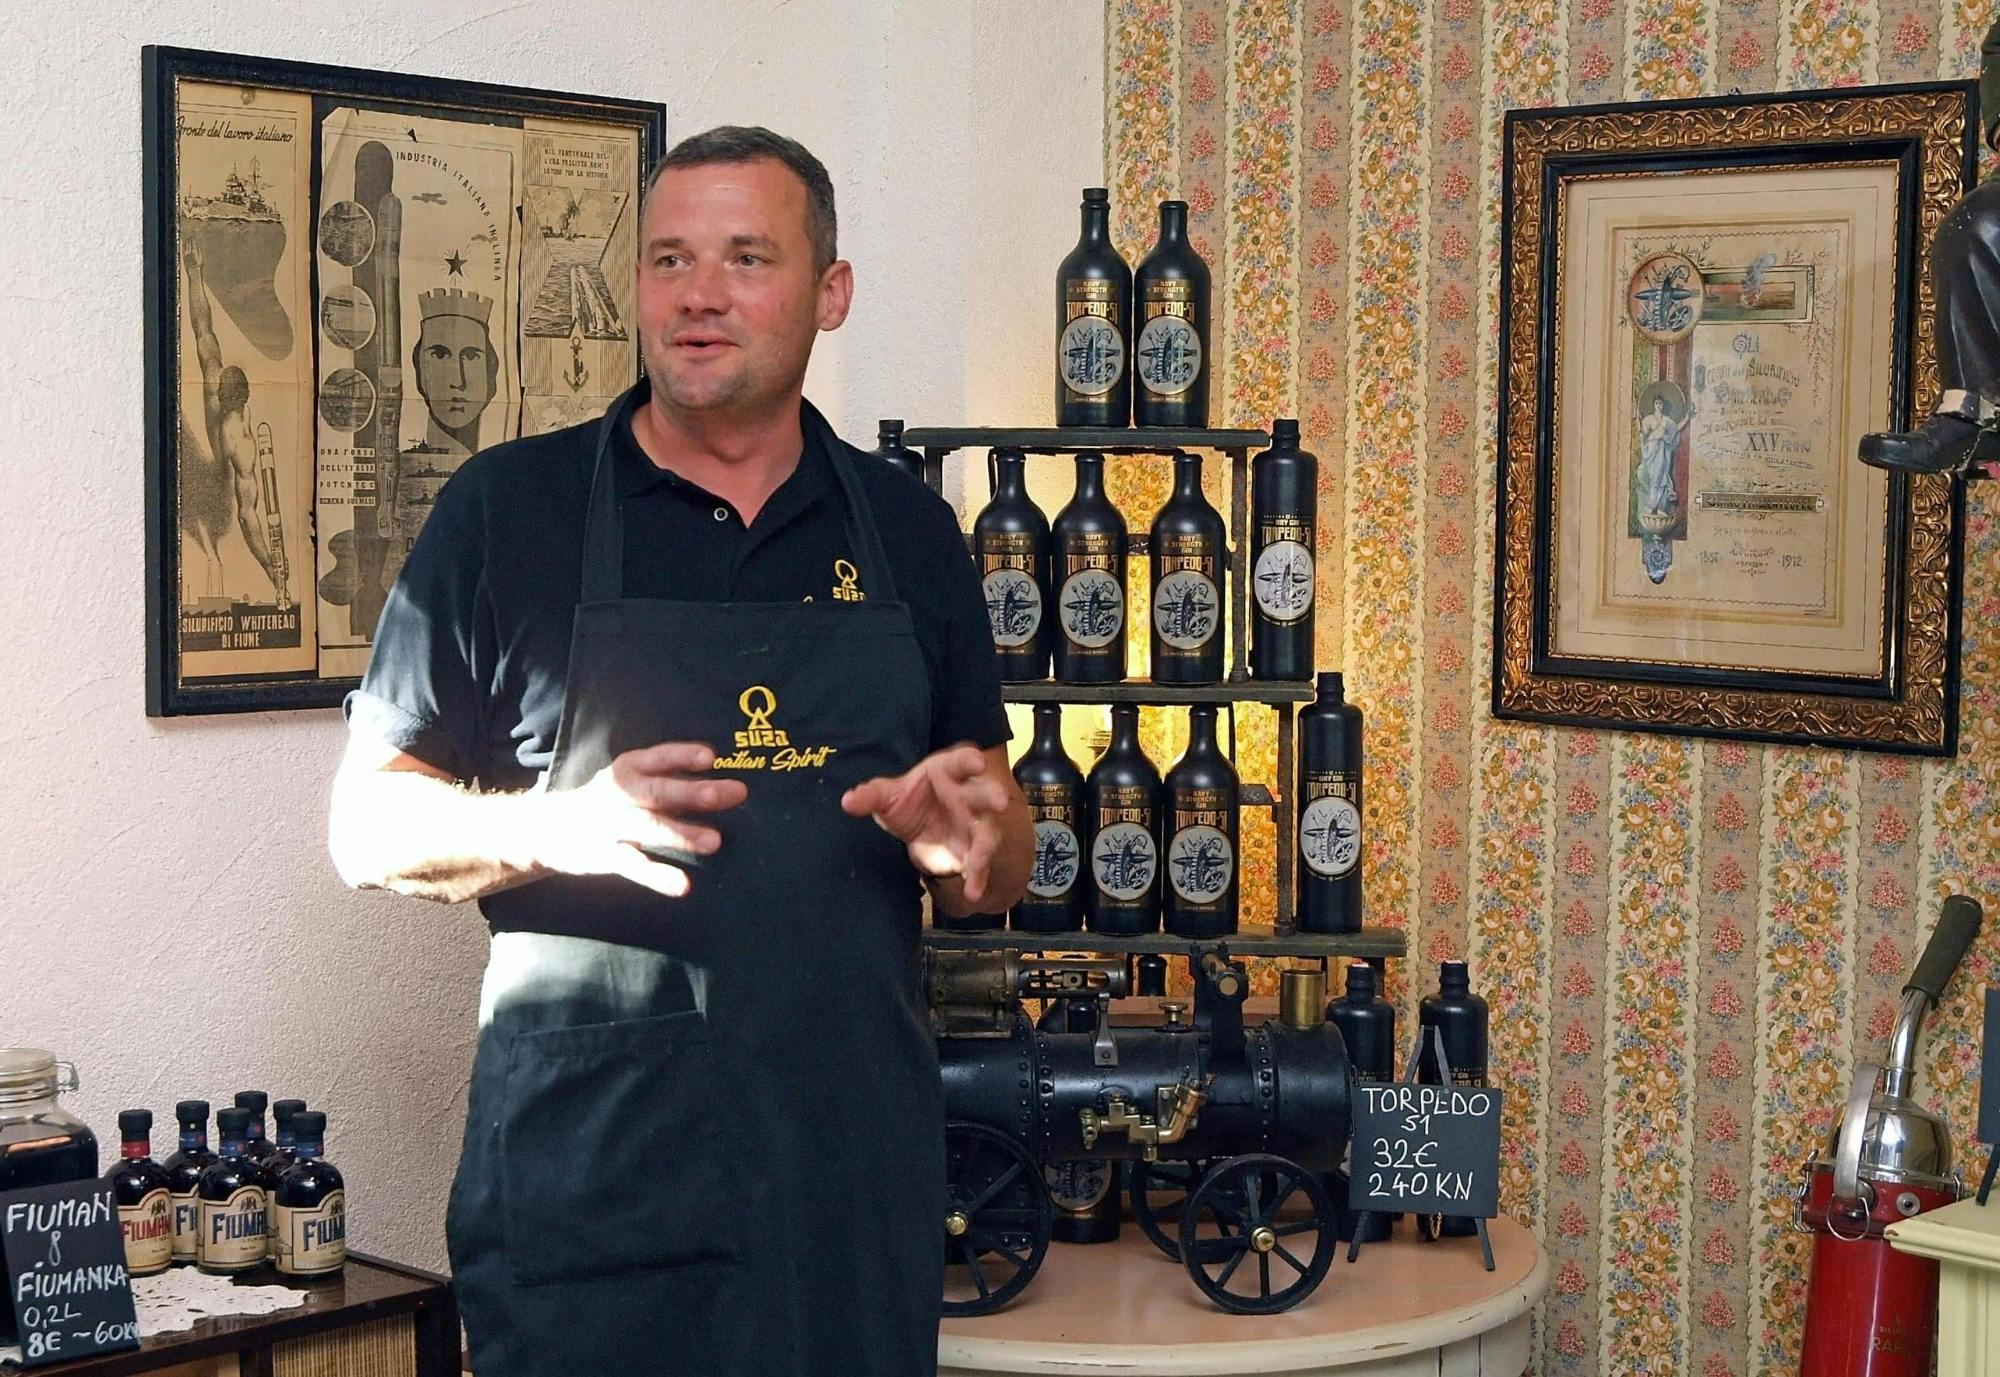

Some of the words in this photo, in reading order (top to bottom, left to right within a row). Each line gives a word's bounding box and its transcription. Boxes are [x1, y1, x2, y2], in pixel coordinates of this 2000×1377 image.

[207, 120, 224, 138] del
[224, 121, 253, 140] lavoro
[255, 125, 293, 142] italiano
[396, 151, 448, 172] INDUSTRIA
[453, 170, 490, 217] ITALIANA
[493, 244, 501, 281] LINEA
[320, 448, 339, 456] UNA
[1746, 432, 1780, 452] XXV
[320, 464, 375, 472] DELL'ITALIA
[182, 616, 234, 633] SILURIFICIO
[240, 614, 296, 631] WHITEHEAD
[221, 633, 231, 648] DI
[234, 632, 260, 648] FIUME
[713, 749, 767, 770] oatian
[770, 746, 838, 772] Spirit
[1361, 1087, 1491, 1116] TORPEDO
[1373, 1138, 1439, 1168] 32€
[1368, 1172, 1429, 1198] 240
[1435, 1171, 1474, 1201] KN
[7, 1191, 112, 1233] FIUMAN
[212, 1207, 267, 1245] FIUMA
[302, 1213, 344, 1252] FIUM
[17, 1264, 129, 1303] FIUMANKA
[23, 1303, 82, 1329] 0,2L
